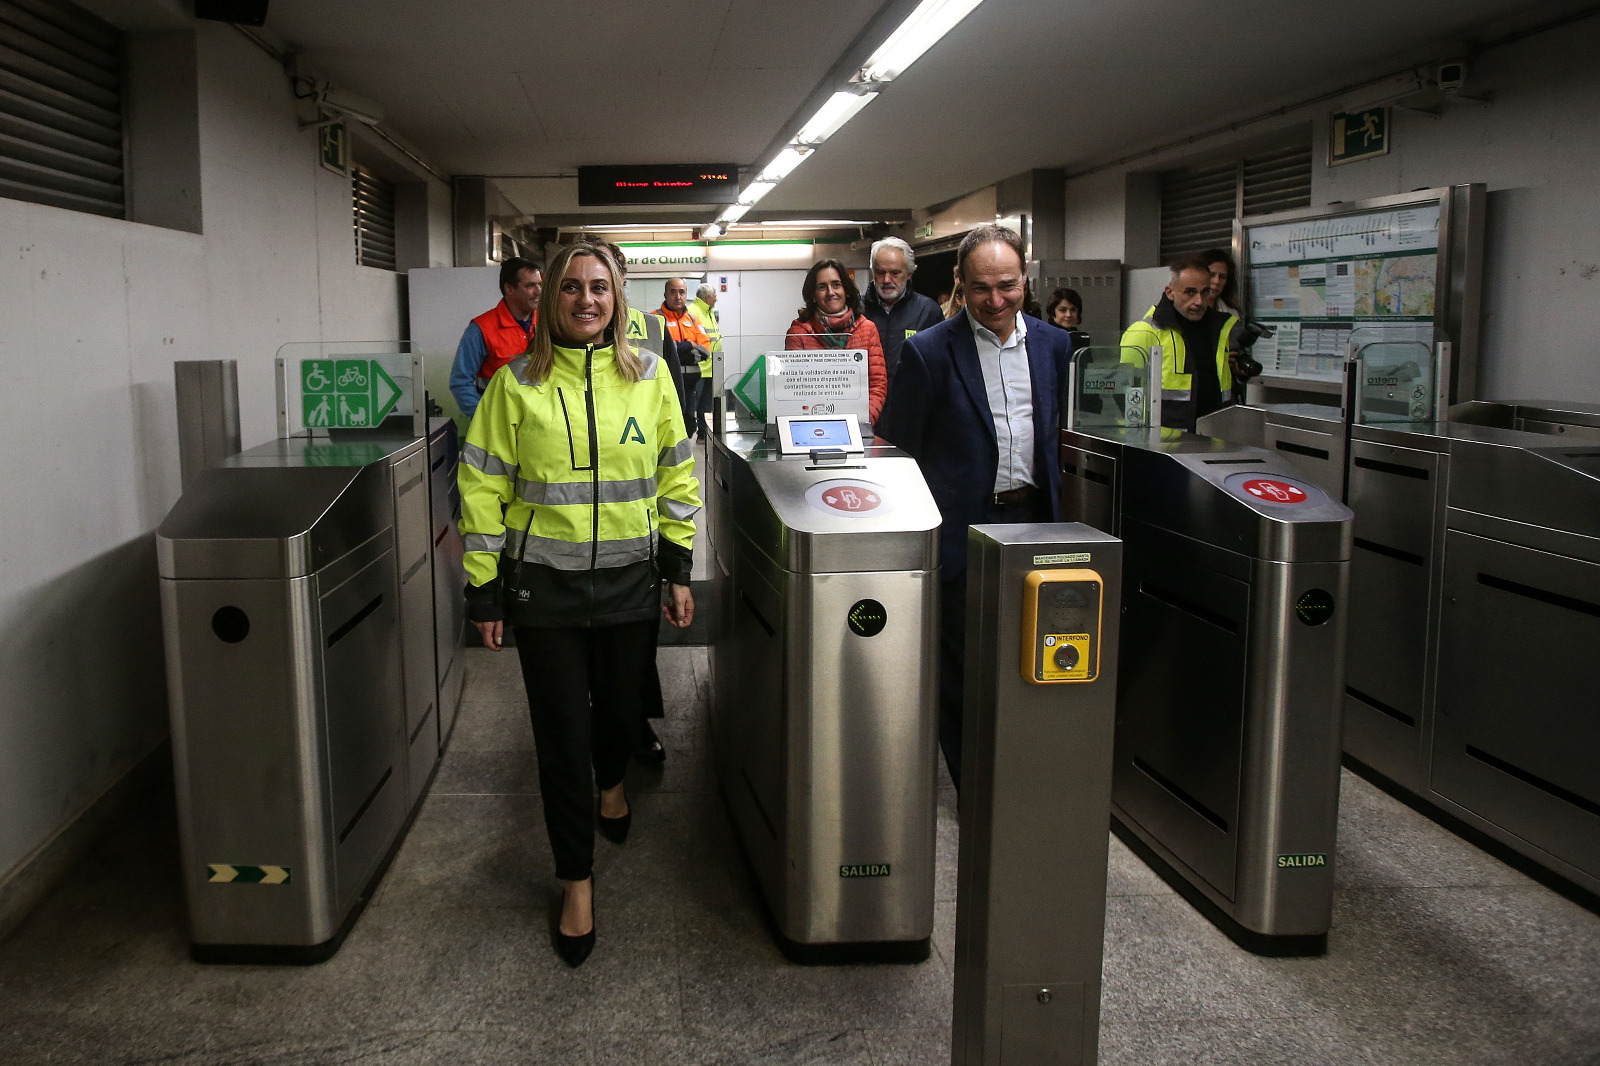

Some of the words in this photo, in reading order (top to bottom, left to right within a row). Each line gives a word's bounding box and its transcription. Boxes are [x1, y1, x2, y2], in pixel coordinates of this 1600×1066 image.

[641, 256, 656, 265] de
[658, 255, 708, 265] Quintos
[1278, 855, 1325, 867] SALIDA
[841, 865, 889, 877] SALIDA
